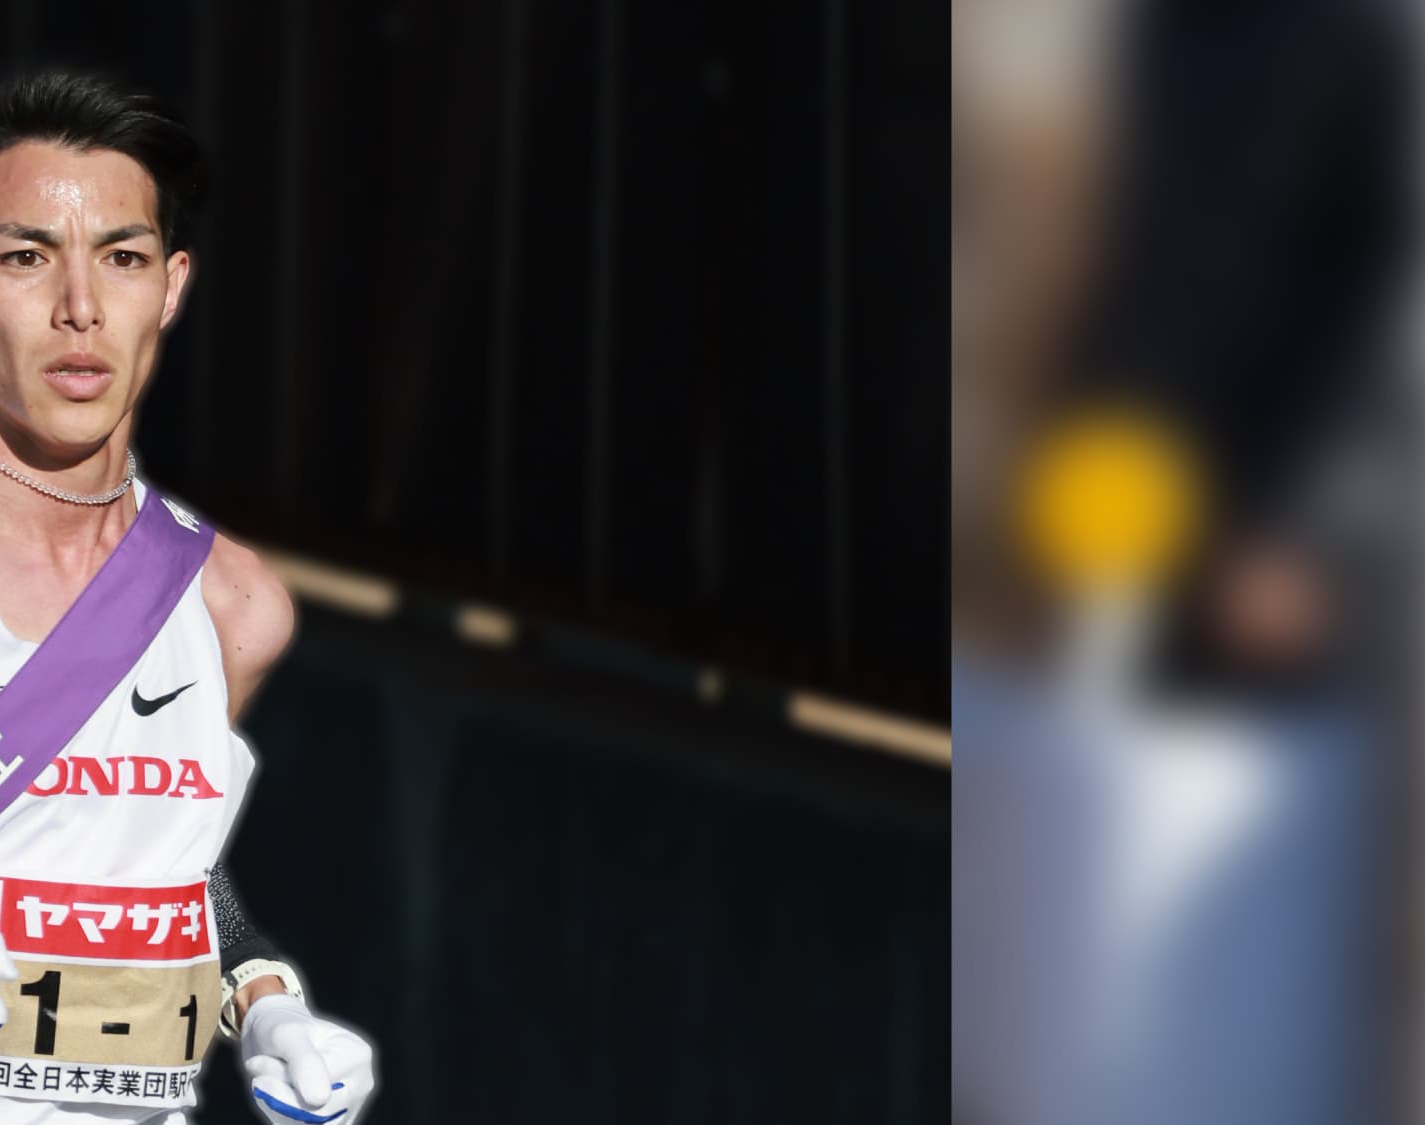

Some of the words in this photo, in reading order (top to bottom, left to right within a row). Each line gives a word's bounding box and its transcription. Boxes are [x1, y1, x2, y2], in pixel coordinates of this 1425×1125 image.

[25, 755, 225, 800] ONDA
[16, 896, 203, 945] ヤマザキ
